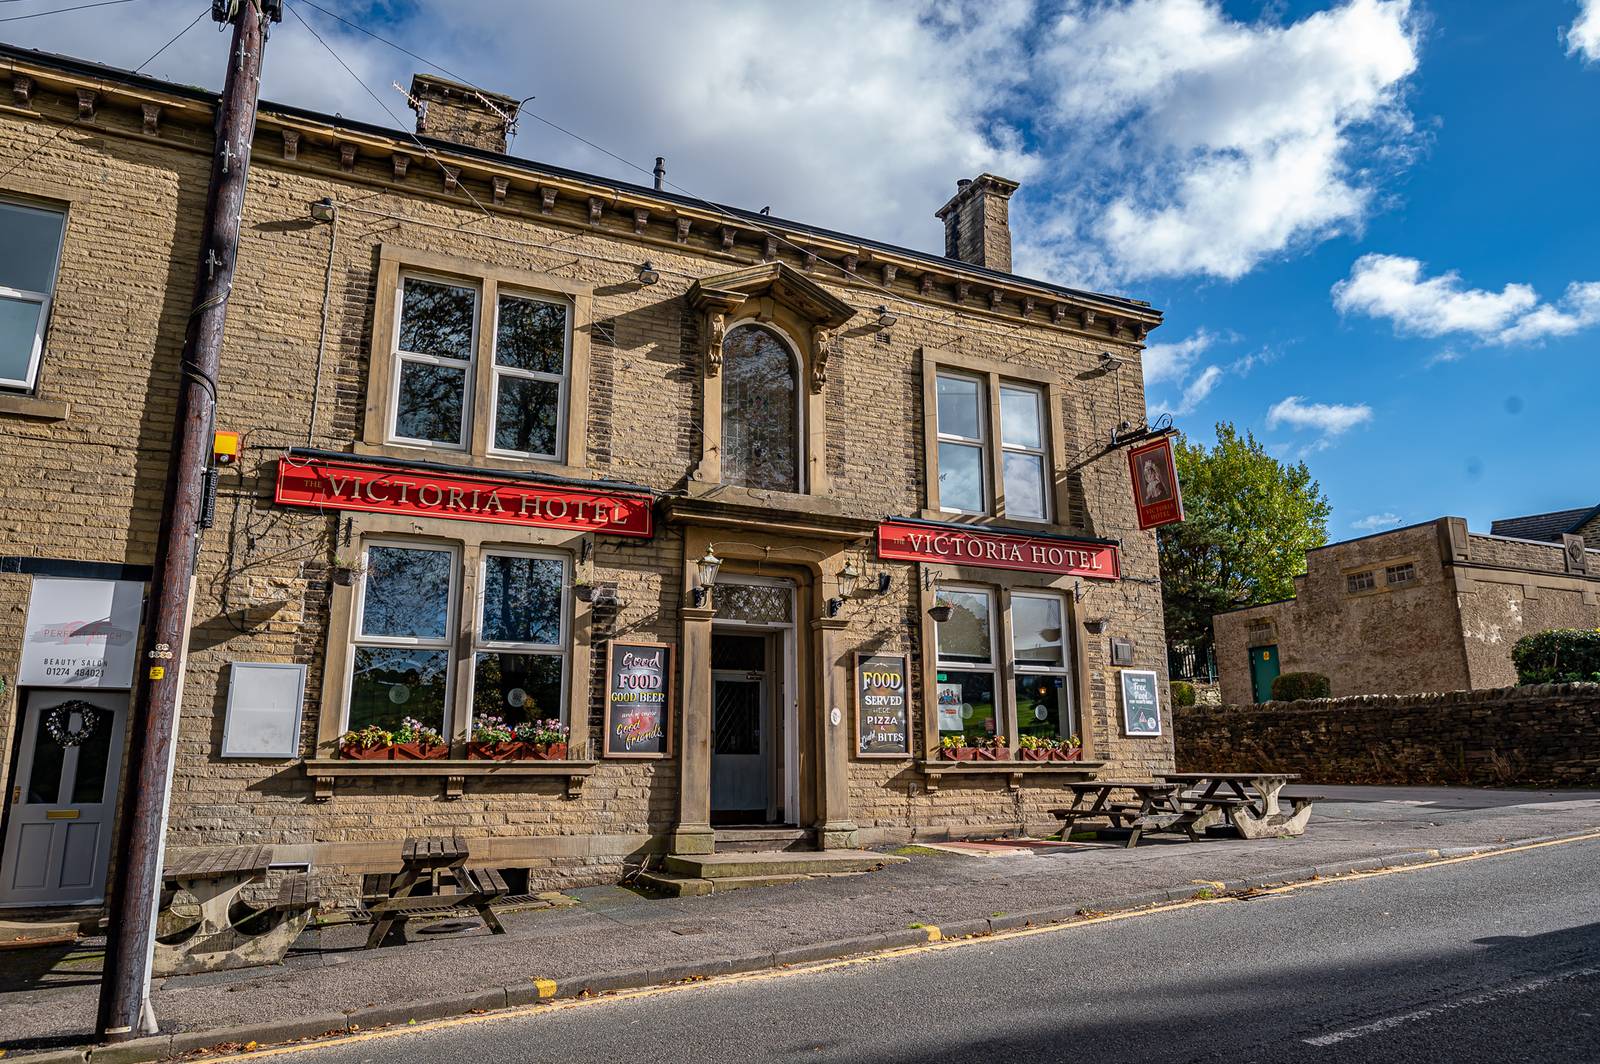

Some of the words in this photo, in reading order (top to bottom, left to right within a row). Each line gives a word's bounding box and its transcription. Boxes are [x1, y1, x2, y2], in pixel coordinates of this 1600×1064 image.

[304, 480, 322, 488] THE
[327, 474, 505, 513] VICTORIA
[519, 494, 627, 525] HOTEL
[907, 533, 1024, 562] VICTORIA
[1031, 546, 1102, 569] HOTEL
[44, 629, 86, 639] PERF
[44, 658, 77, 666] BEAUTY
[622, 652, 661, 669] Good
[46, 667, 70, 676] 01274
[75, 668, 105, 677] 484021
[619, 674, 662, 689] FOOD
[863, 672, 901, 690] FOOD
[612, 692, 637, 702] GOOD
[639, 692, 665, 702] BEER
[865, 695, 902, 706] SERVED
[867, 716, 898, 725] PIZZA
[616, 720, 640, 738] Good
[878, 733, 904, 742] BITES
